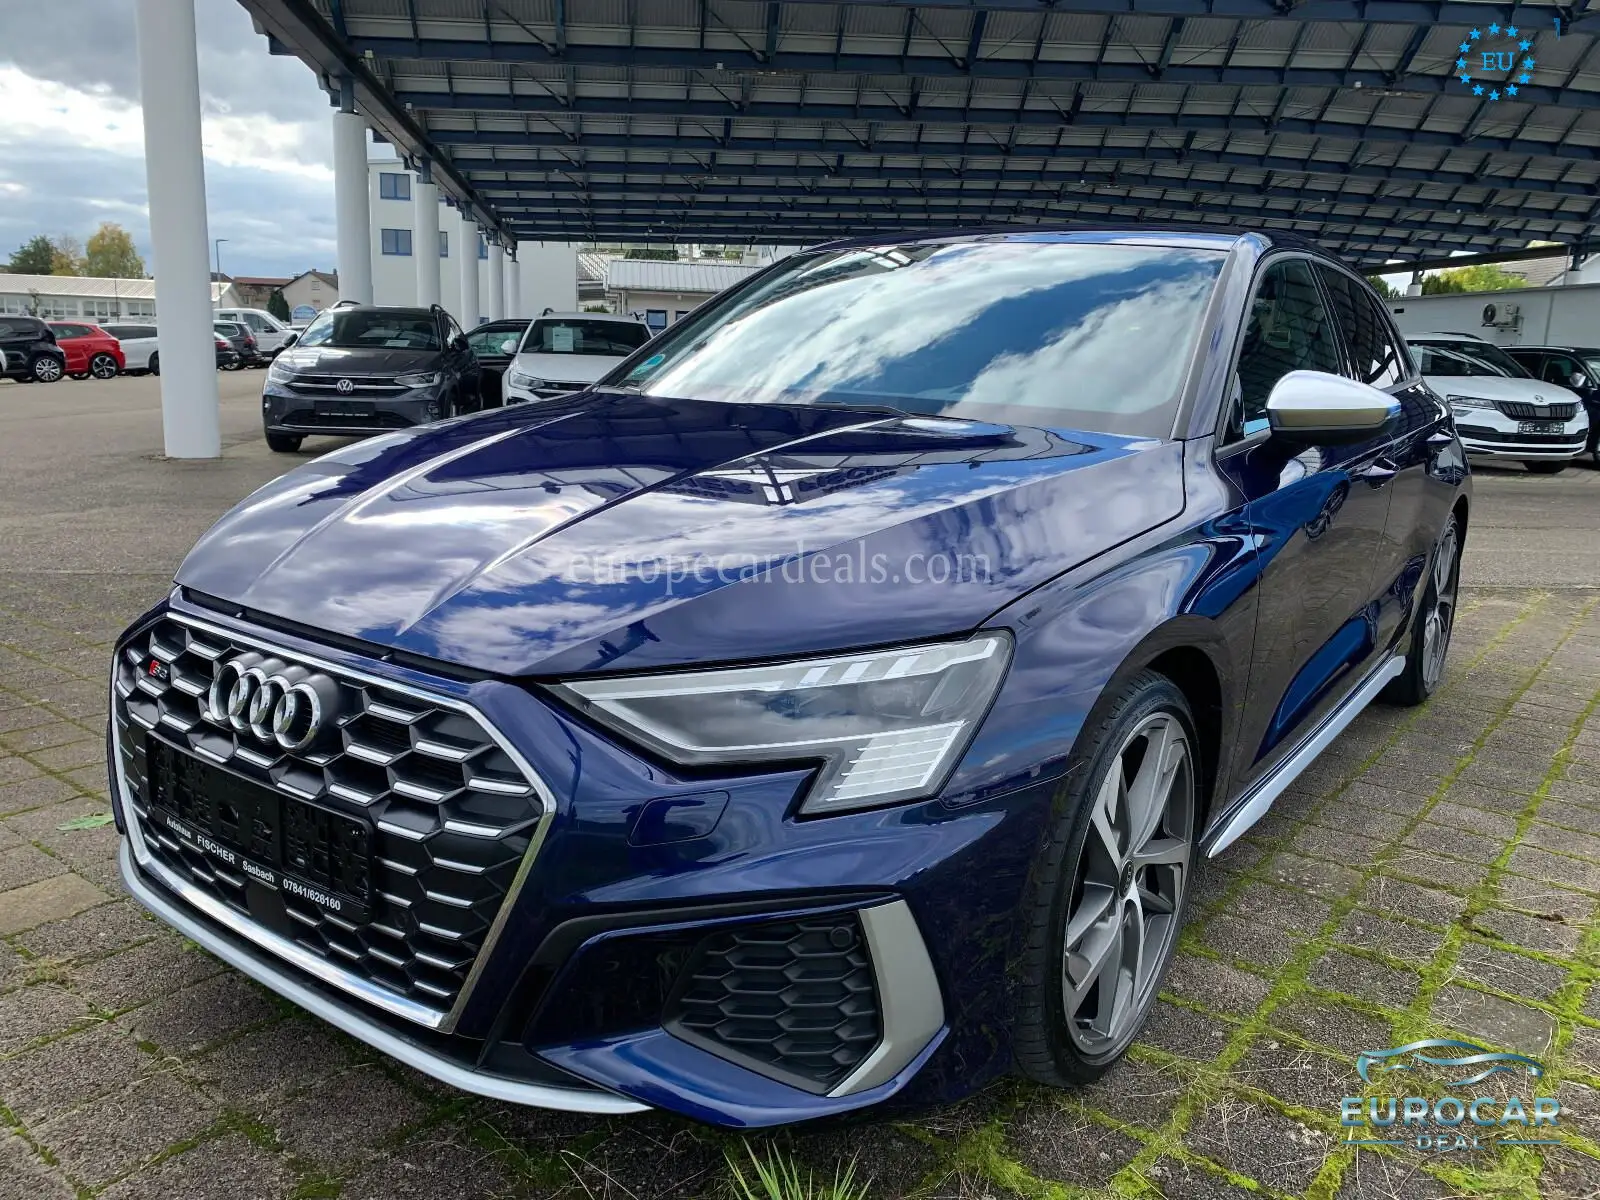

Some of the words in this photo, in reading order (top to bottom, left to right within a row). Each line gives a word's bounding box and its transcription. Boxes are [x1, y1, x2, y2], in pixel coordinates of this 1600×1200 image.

[166, 816, 192, 839] Autohaus
[197, 835, 235, 864] FISCHER
[242, 860, 275, 882] Sasbach
[282, 878, 341, 911] 07841/626160
